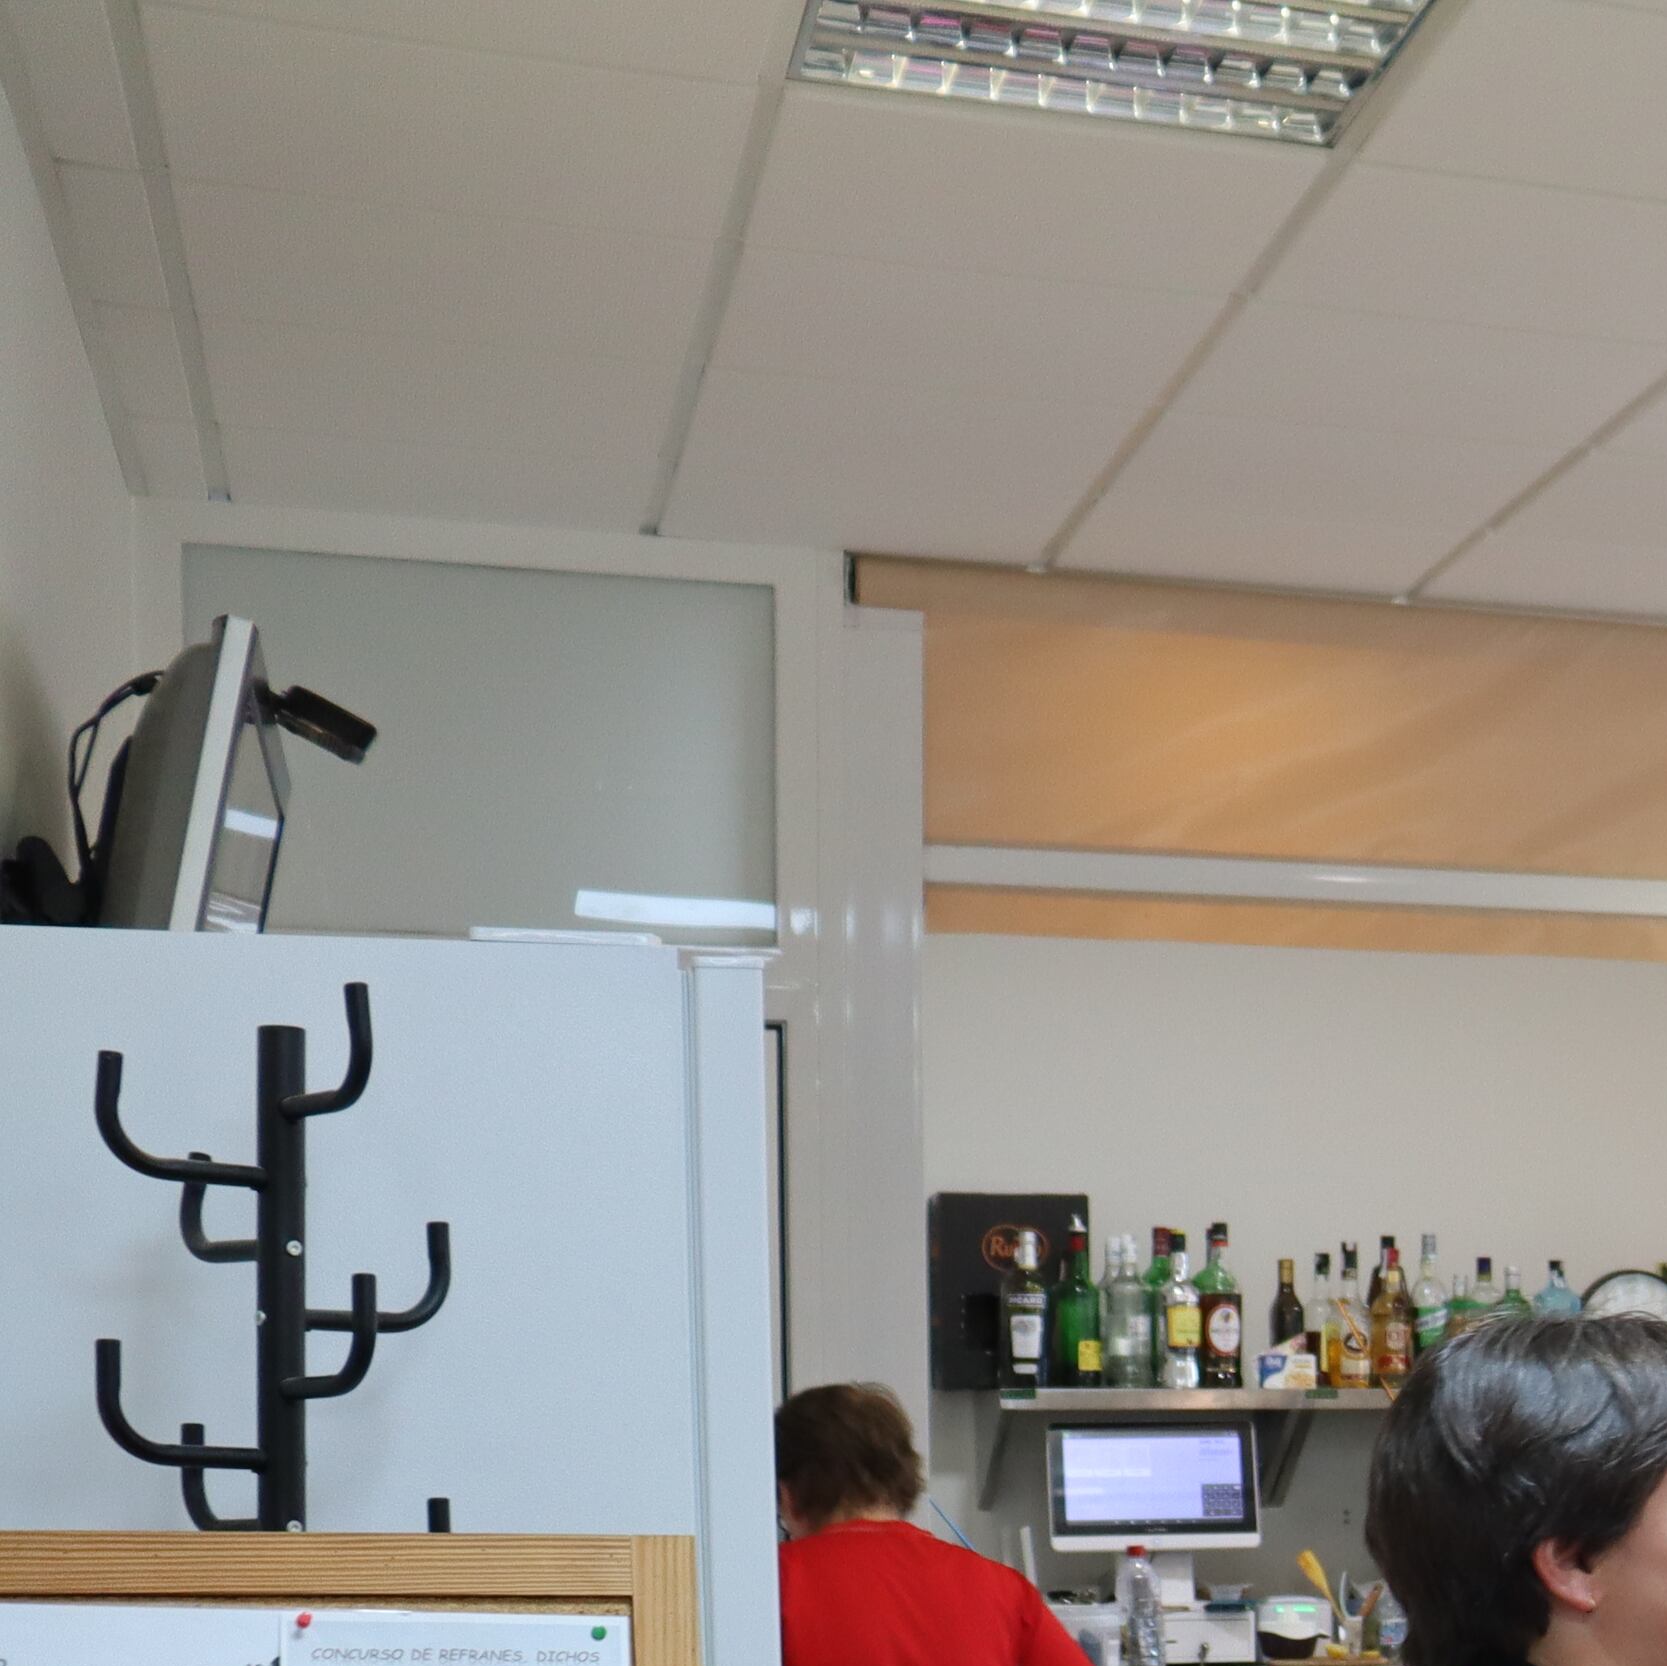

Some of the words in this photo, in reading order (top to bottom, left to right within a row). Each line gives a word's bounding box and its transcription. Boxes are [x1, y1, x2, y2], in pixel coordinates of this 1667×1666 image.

[311, 1648, 404, 1663] CONCURSO
[411, 1648, 433, 1663] DE
[536, 1650, 601, 1664] DICHOS
